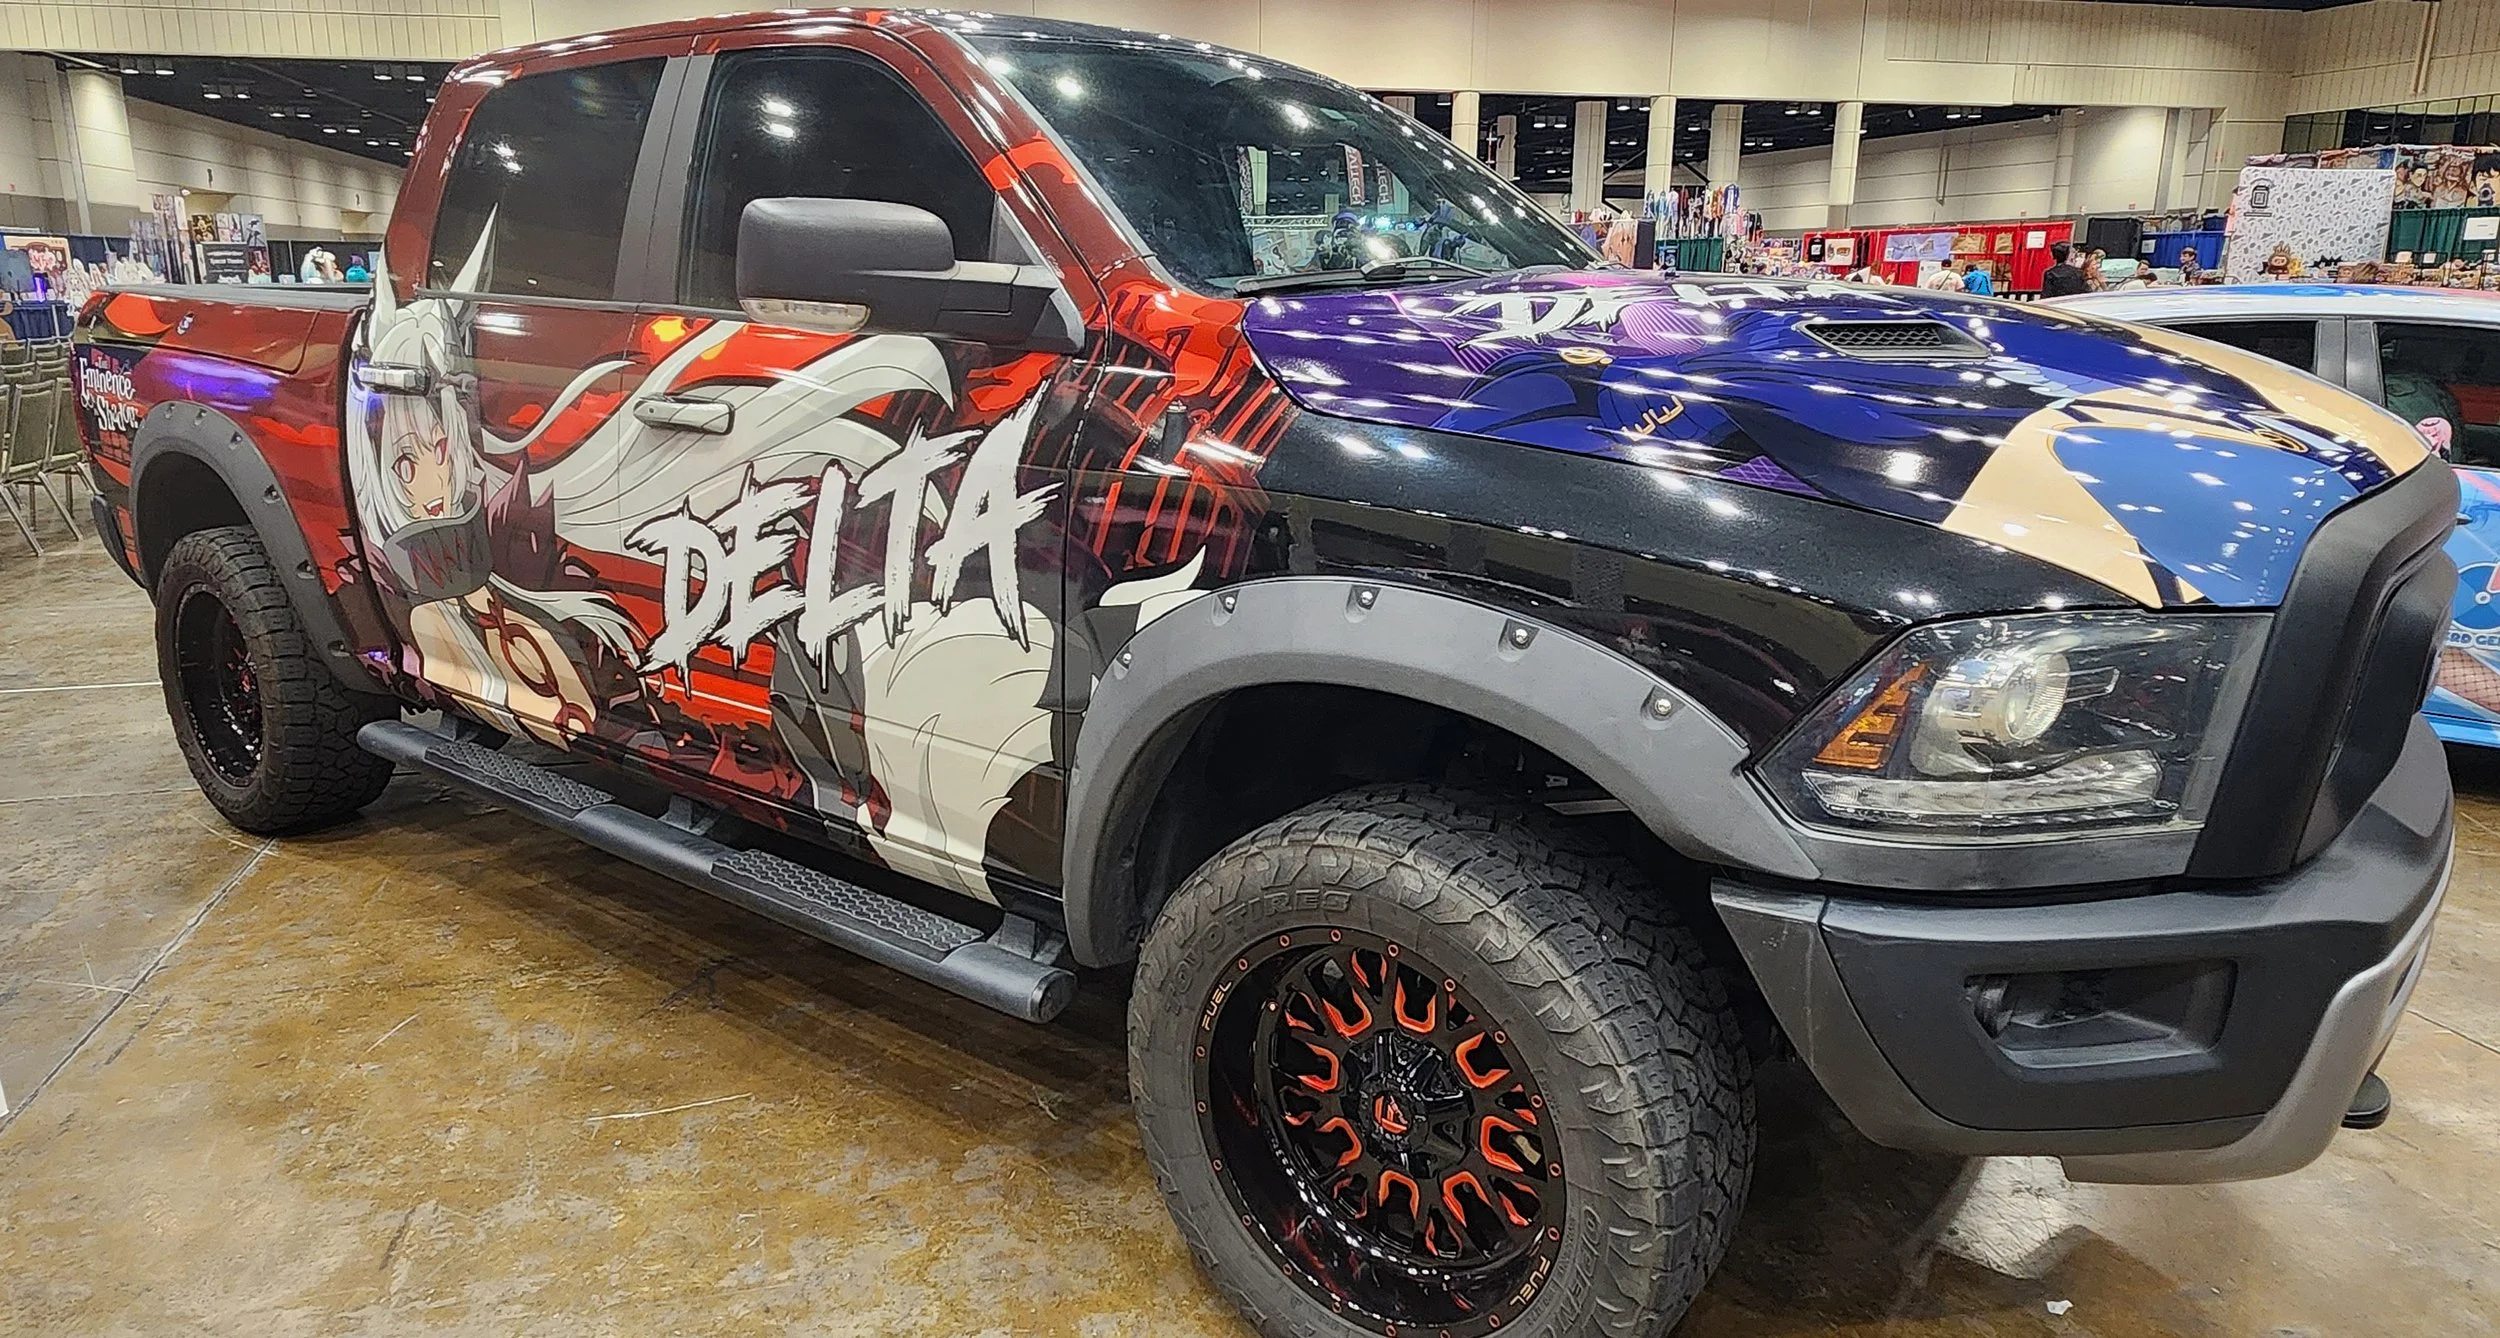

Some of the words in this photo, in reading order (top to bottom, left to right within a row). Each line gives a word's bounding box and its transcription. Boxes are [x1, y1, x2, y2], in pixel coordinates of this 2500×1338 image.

[625, 378, 1065, 698] DELTA
[1201, 981, 1233, 1031] FUEL
[1509, 1255, 1551, 1306] FUEL
